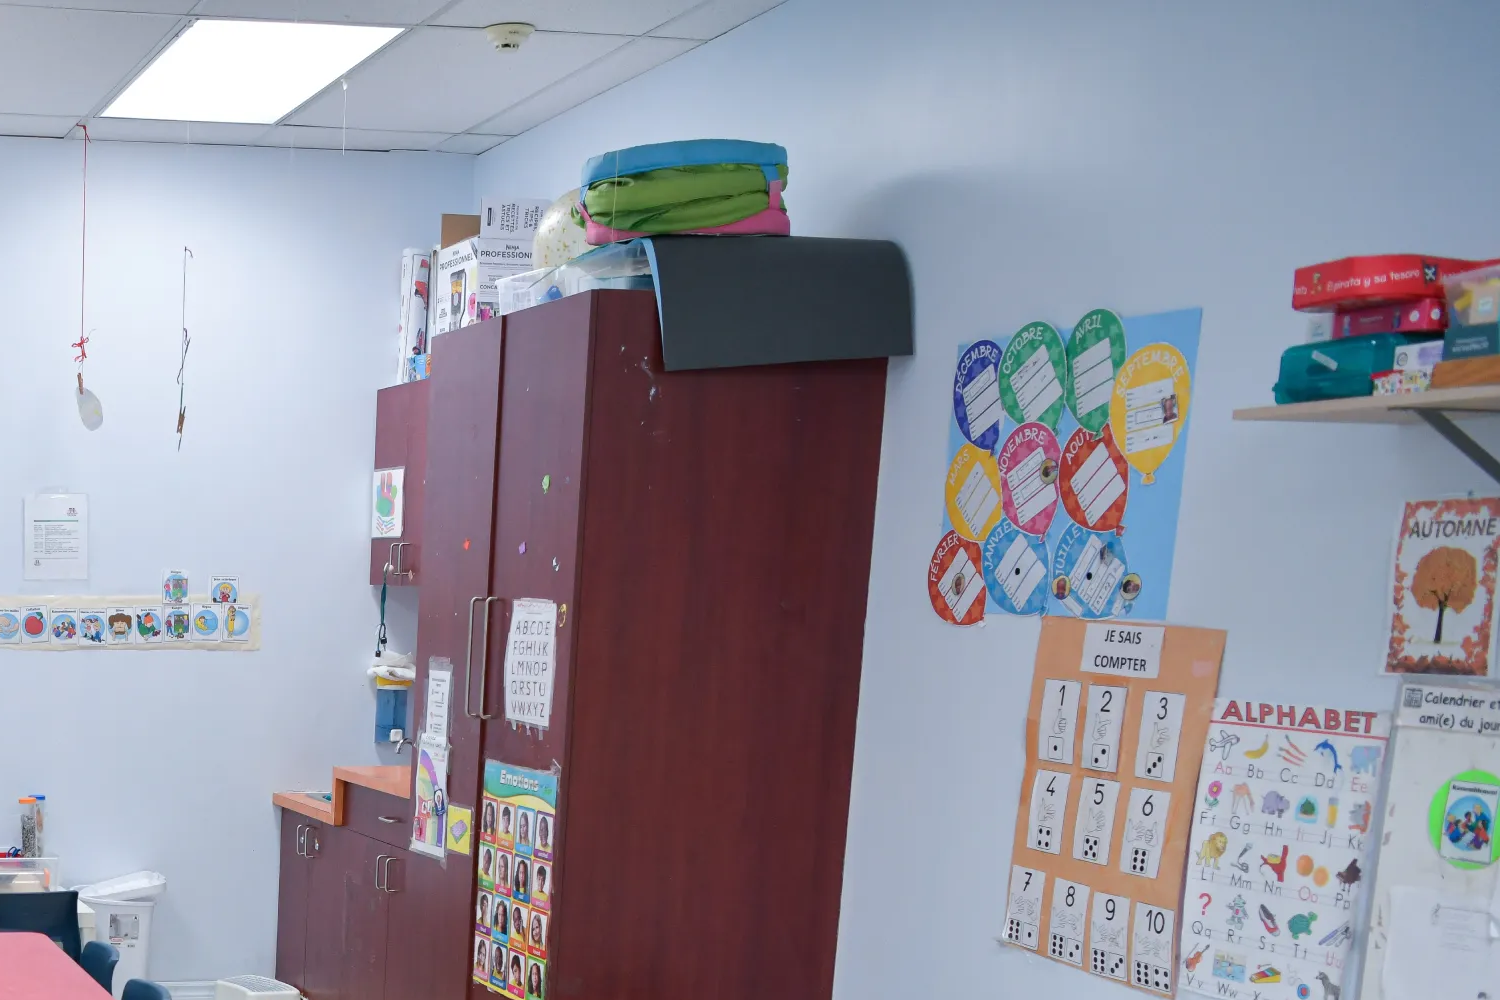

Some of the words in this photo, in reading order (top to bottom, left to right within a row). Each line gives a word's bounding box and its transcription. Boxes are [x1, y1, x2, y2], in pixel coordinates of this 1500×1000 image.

[440, 253, 474, 271] PROFESSIONNEL
[1364, 278, 1371, 288] y
[1390, 269, 1420, 280] tesoro
[1074, 314, 1102, 344] AVRIL
[1002, 326, 1044, 374] OCTOBRE
[955, 346, 999, 394] DÉCEMBRE
[1116, 349, 1185, 398] SEPTEMBRE
[998, 428, 1046, 477] NOVEMBRE
[949, 448, 970, 485] MARS
[1408, 518, 1497, 538] AUTOMNE
[984, 520, 1014, 570] JANVIE
[1056, 525, 1086, 576] JUILLE
[930, 534, 960, 582] FÉVRIER
[1104, 629, 1116, 643] JE
[1118, 630, 1142, 645] SAIS
[1094, 654, 1147, 672] COMPTER
[1058, 684, 1066, 706] 1
[1100, 690, 1113, 713] 2
[1424, 692, 1485, 709] Calendrier
[1156, 696, 1168, 720] 3
[1220, 700, 1378, 734] ALPHABET
[1419, 713, 1455, 730] ami(e)
[1460, 716, 1474, 729] du
[1214, 761, 1232, 776] Aa
[1247, 764, 1264, 780] Bb
[1280, 768, 1298, 784] Cc
[500, 770, 540, 792] Emotions
[1046, 776, 1057, 797] 4
[1314, 772, 1334, 789] Dd
[1350, 776, 1368, 793] Ee
[1093, 783, 1105, 805] 5
[1142, 794, 1154, 816] 6
[1200, 812, 1216, 826] Ff
[1230, 816, 1250, 835] Gg
[1023, 872, 1032, 892] 7
[1230, 874, 1252, 890] Mm
[1264, 880, 1282, 896] Nn
[1066, 886, 1076, 907] 8
[1298, 886, 1318, 903] Oo
[1105, 898, 1116, 921] 9
[1146, 909, 1165, 934] 10
